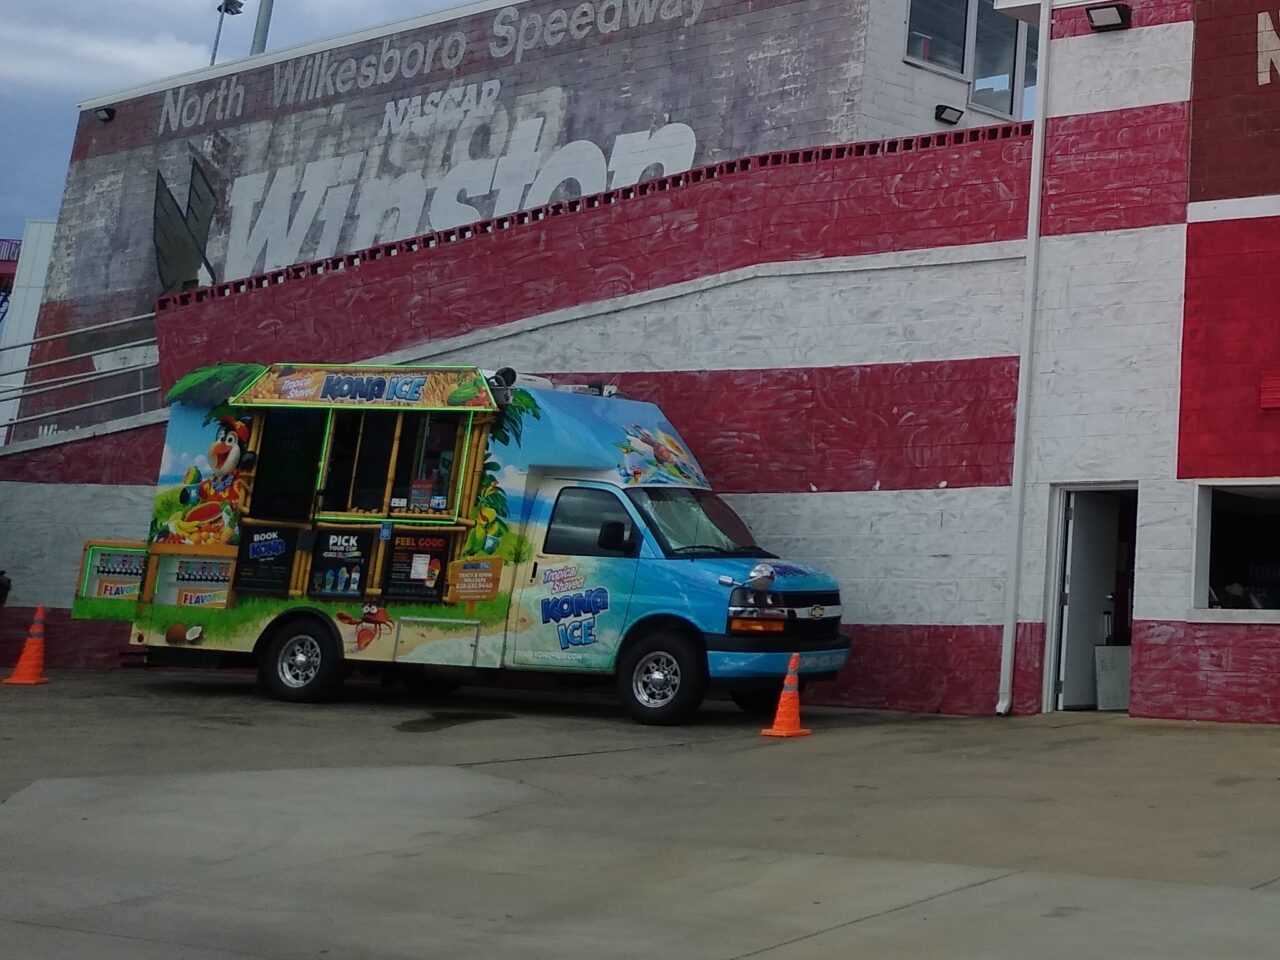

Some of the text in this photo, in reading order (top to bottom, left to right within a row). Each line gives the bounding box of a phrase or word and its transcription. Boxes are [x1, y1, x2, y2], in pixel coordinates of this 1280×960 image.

[158, 77, 246, 137] North
[273, 31, 467, 109] Wilkesboro
[378, 80, 501, 139] NASCAR
[319, 374, 388, 403] KONA
[385, 375, 428, 403] ICE
[253, 531, 279, 542] BOOK
[329, 535, 358, 547] PICK
[395, 537, 445, 547] FEEL GOOD
[249, 538, 285, 559] KONA
[543, 564, 578, 584] Tropical
[551, 576, 585, 594] Shaved
[540, 587, 609, 625] KONA
[557, 616, 597, 651] ICE
